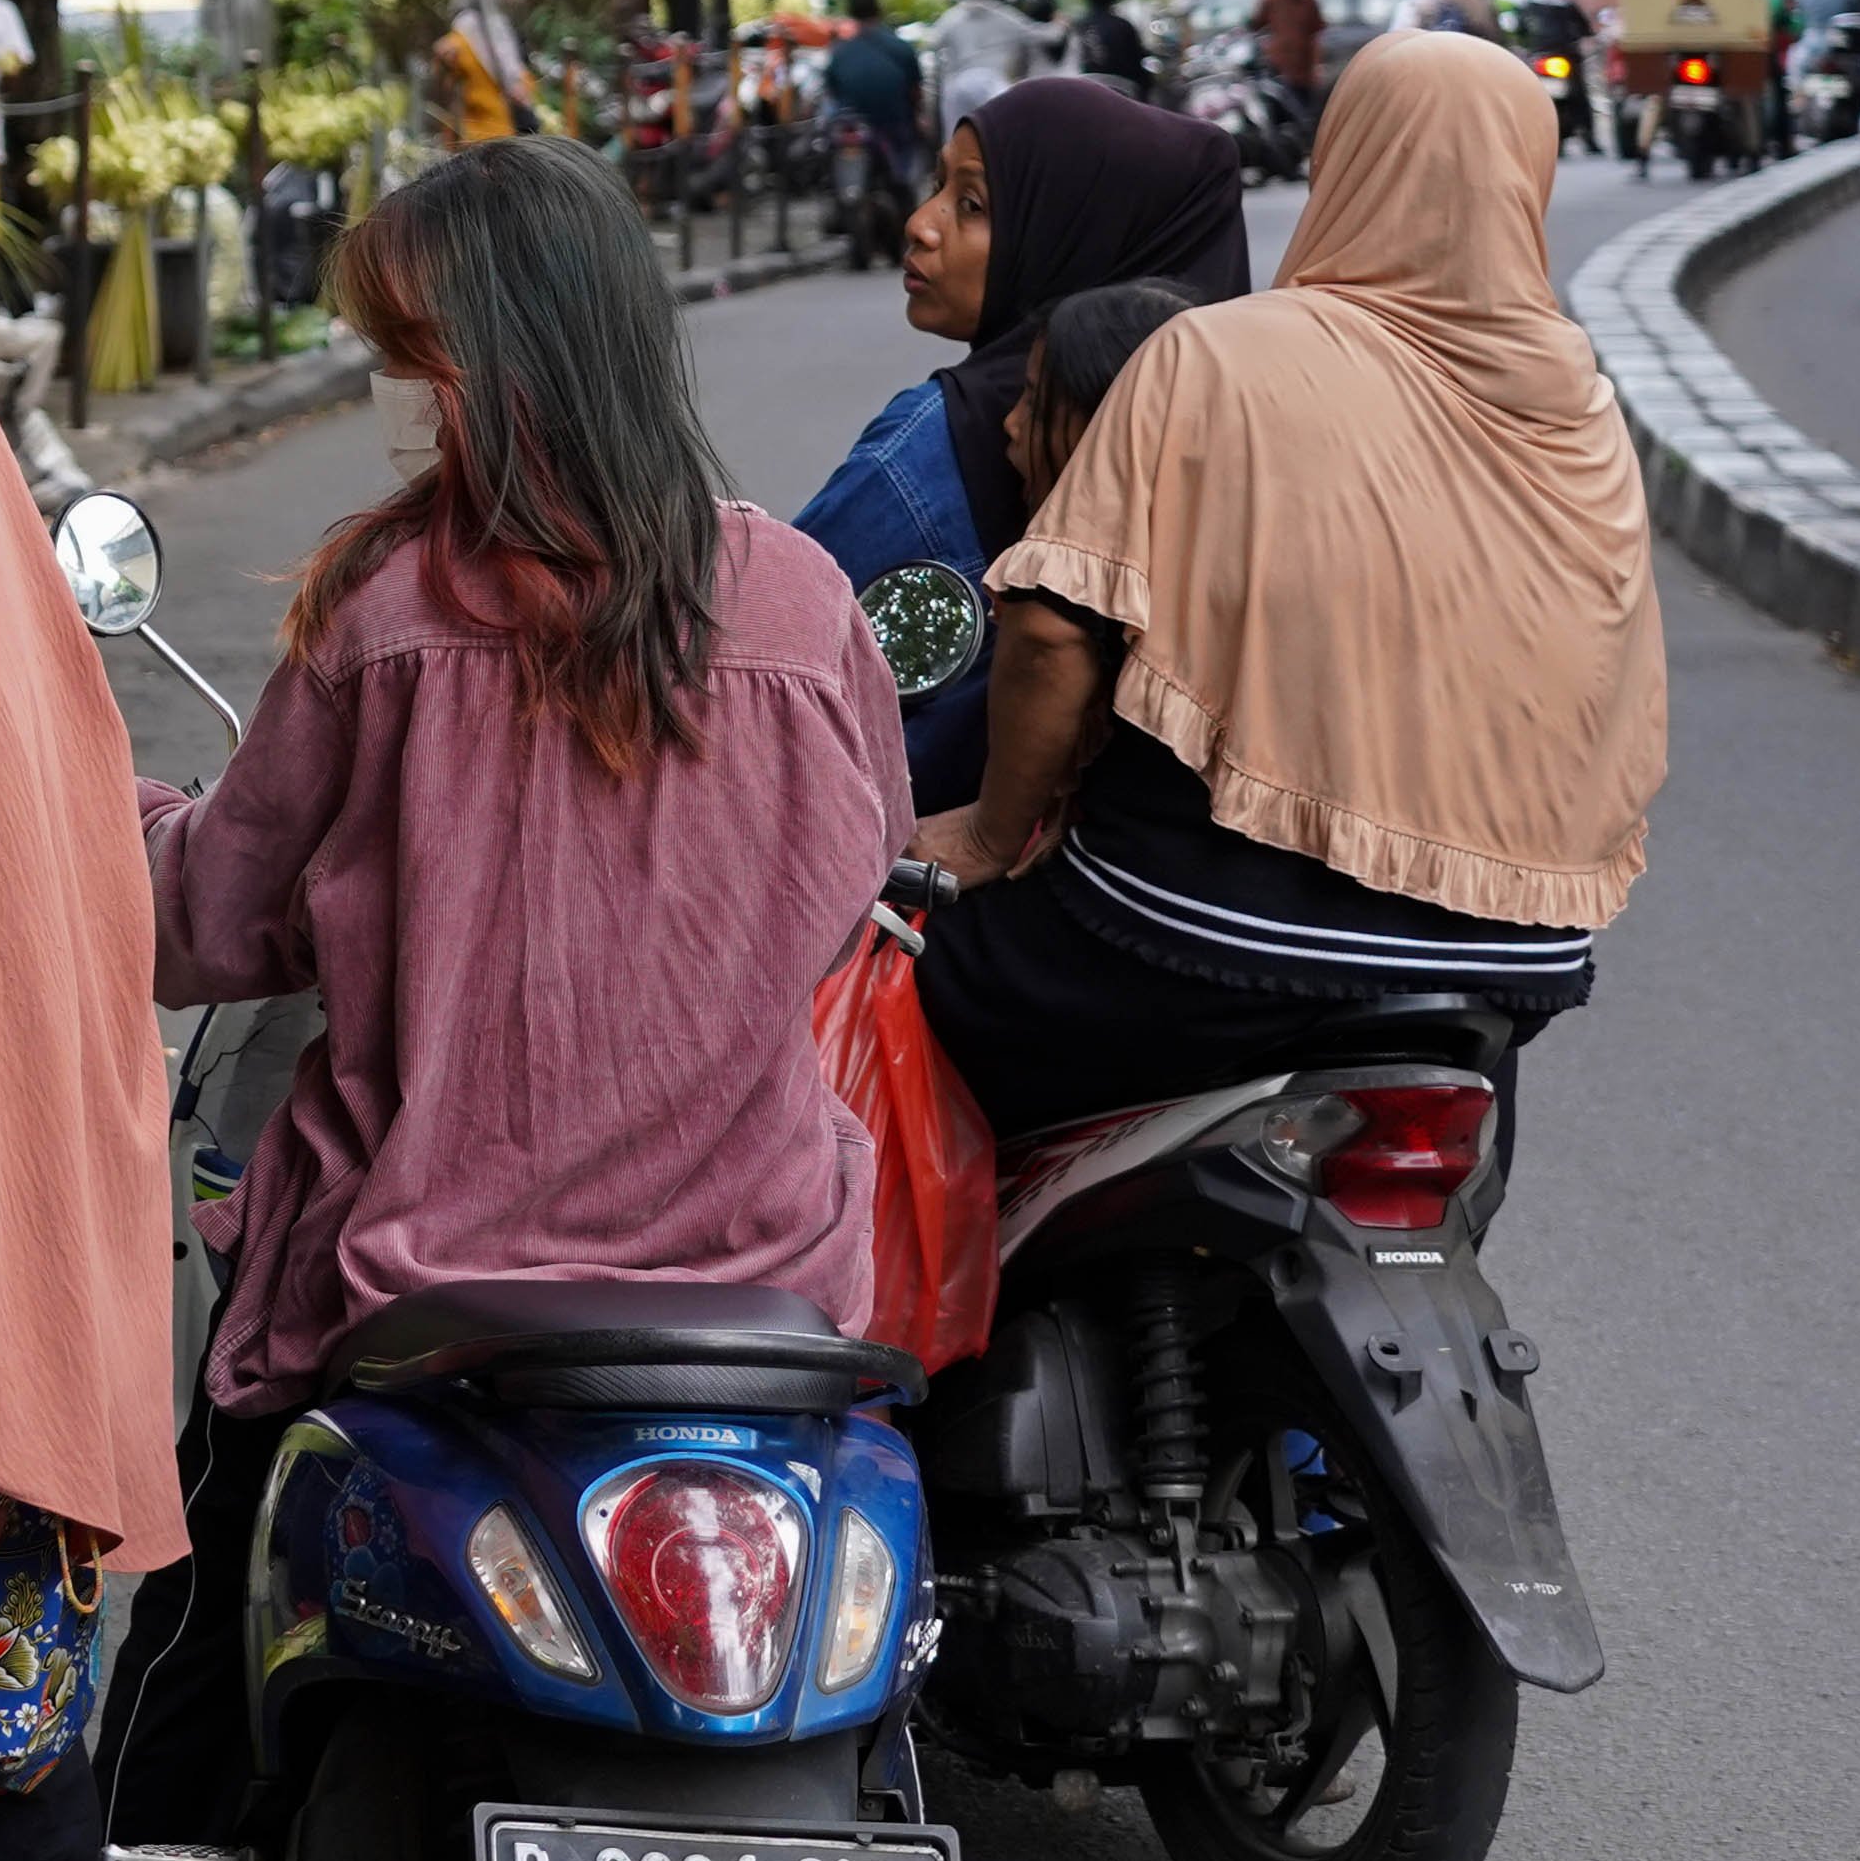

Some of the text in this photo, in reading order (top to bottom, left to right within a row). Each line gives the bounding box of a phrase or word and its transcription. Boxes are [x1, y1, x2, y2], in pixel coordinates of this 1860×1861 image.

[1375, 1251, 1445, 1264] HONDA
[634, 1426, 741, 1445] HONDA
[334, 1578, 463, 1660] Scoopy
